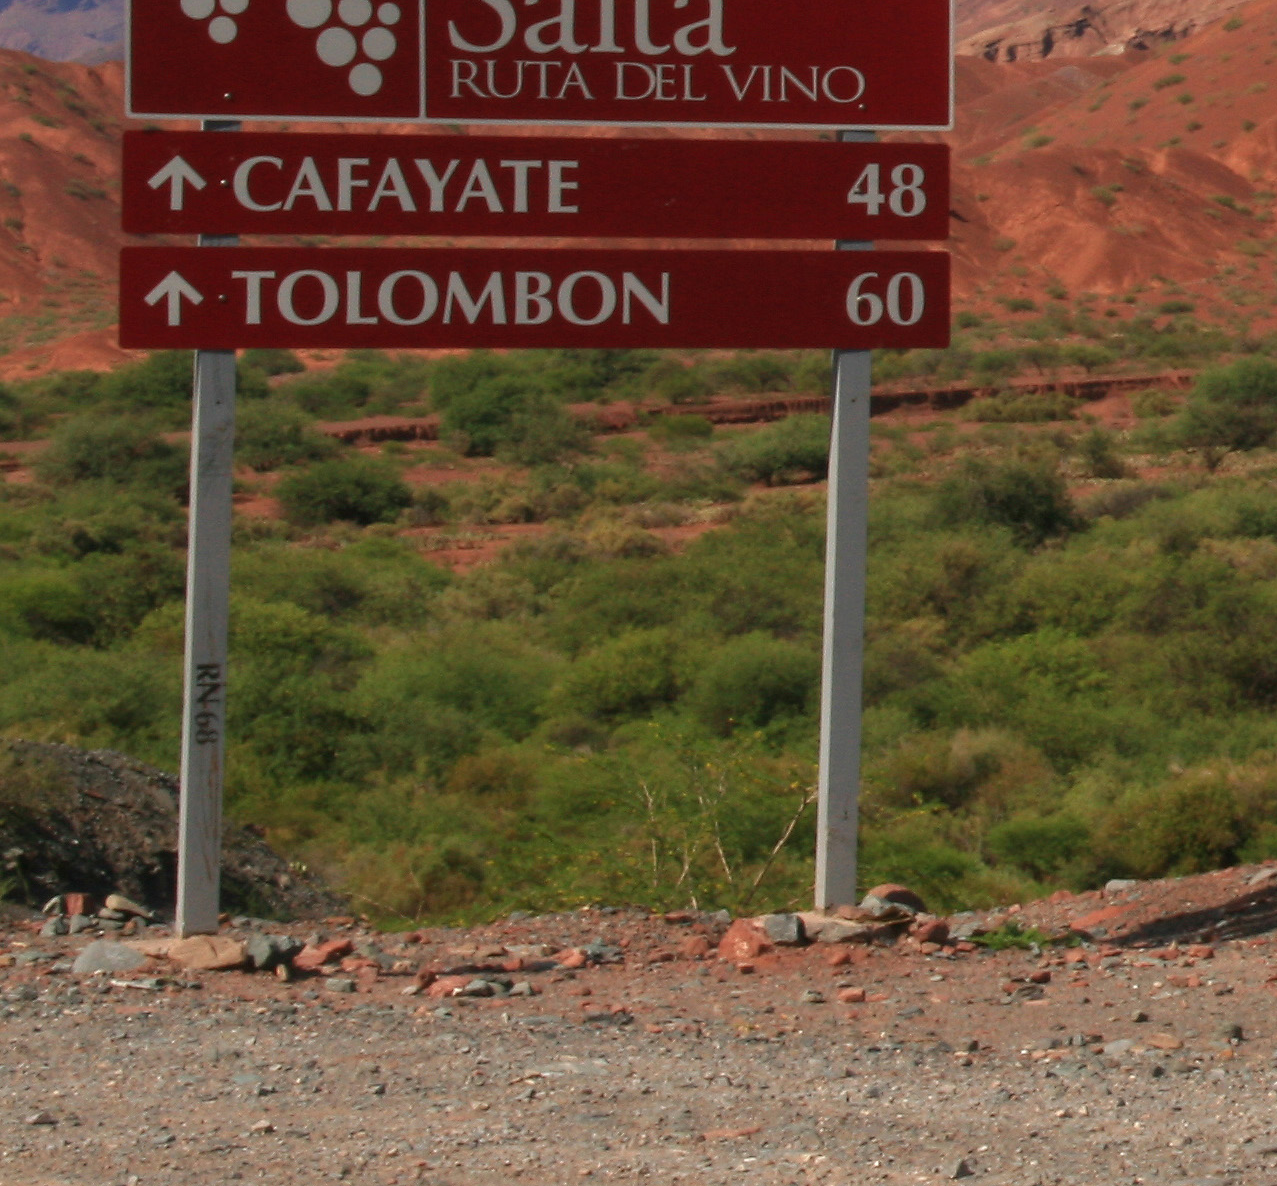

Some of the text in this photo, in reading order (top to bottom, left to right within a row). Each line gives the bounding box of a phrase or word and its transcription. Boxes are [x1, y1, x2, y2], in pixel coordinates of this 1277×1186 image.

[450, 61, 866, 104] RUTA DEL VINO
[232, 156, 926, 217] CAFAYATE 48
[231, 270, 925, 327] TOLOMBON 60
